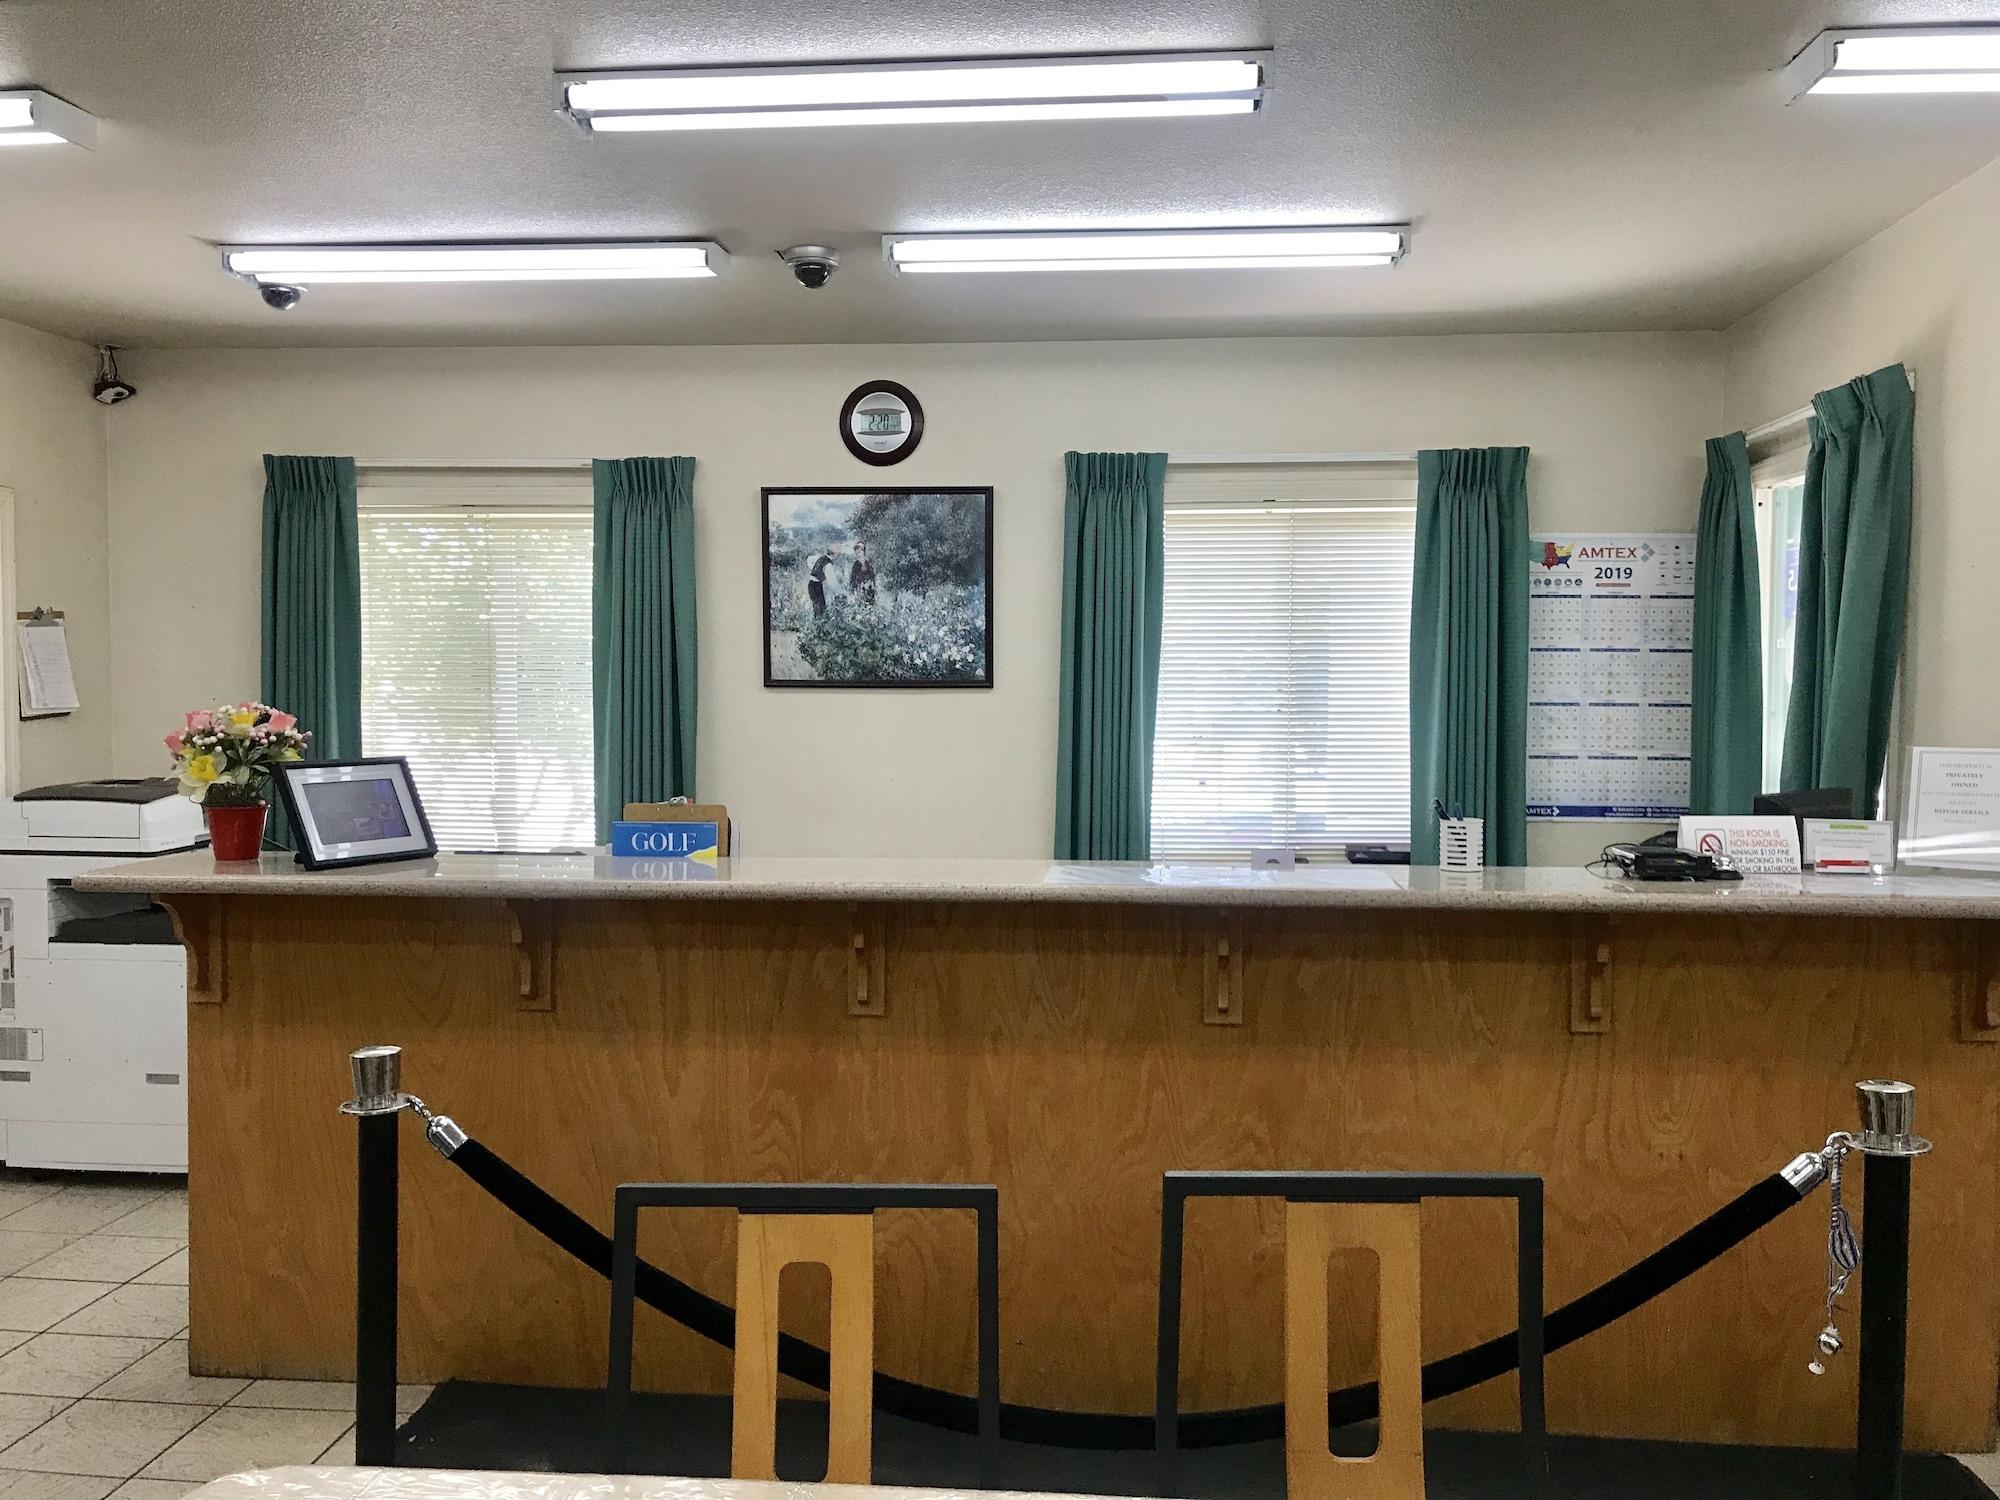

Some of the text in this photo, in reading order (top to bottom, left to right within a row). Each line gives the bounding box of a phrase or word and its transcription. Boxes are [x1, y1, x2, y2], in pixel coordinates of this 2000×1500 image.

[1578, 547, 1638, 559] AMTEX
[1594, 567, 1633, 580] 2019
[1729, 830, 1780, 838] THIS ROOM IS
[631, 832, 697, 852] GOLF
[1730, 848, 1791, 856] MINIMUM $150 FINE
[1744, 856, 1775, 864] SMOKING
[1776, 856, 1783, 864] IN
[1784, 856, 1795, 864] THE
[1752, 865, 1762, 873] OR
[1763, 865, 1799, 873] BATHROOM
